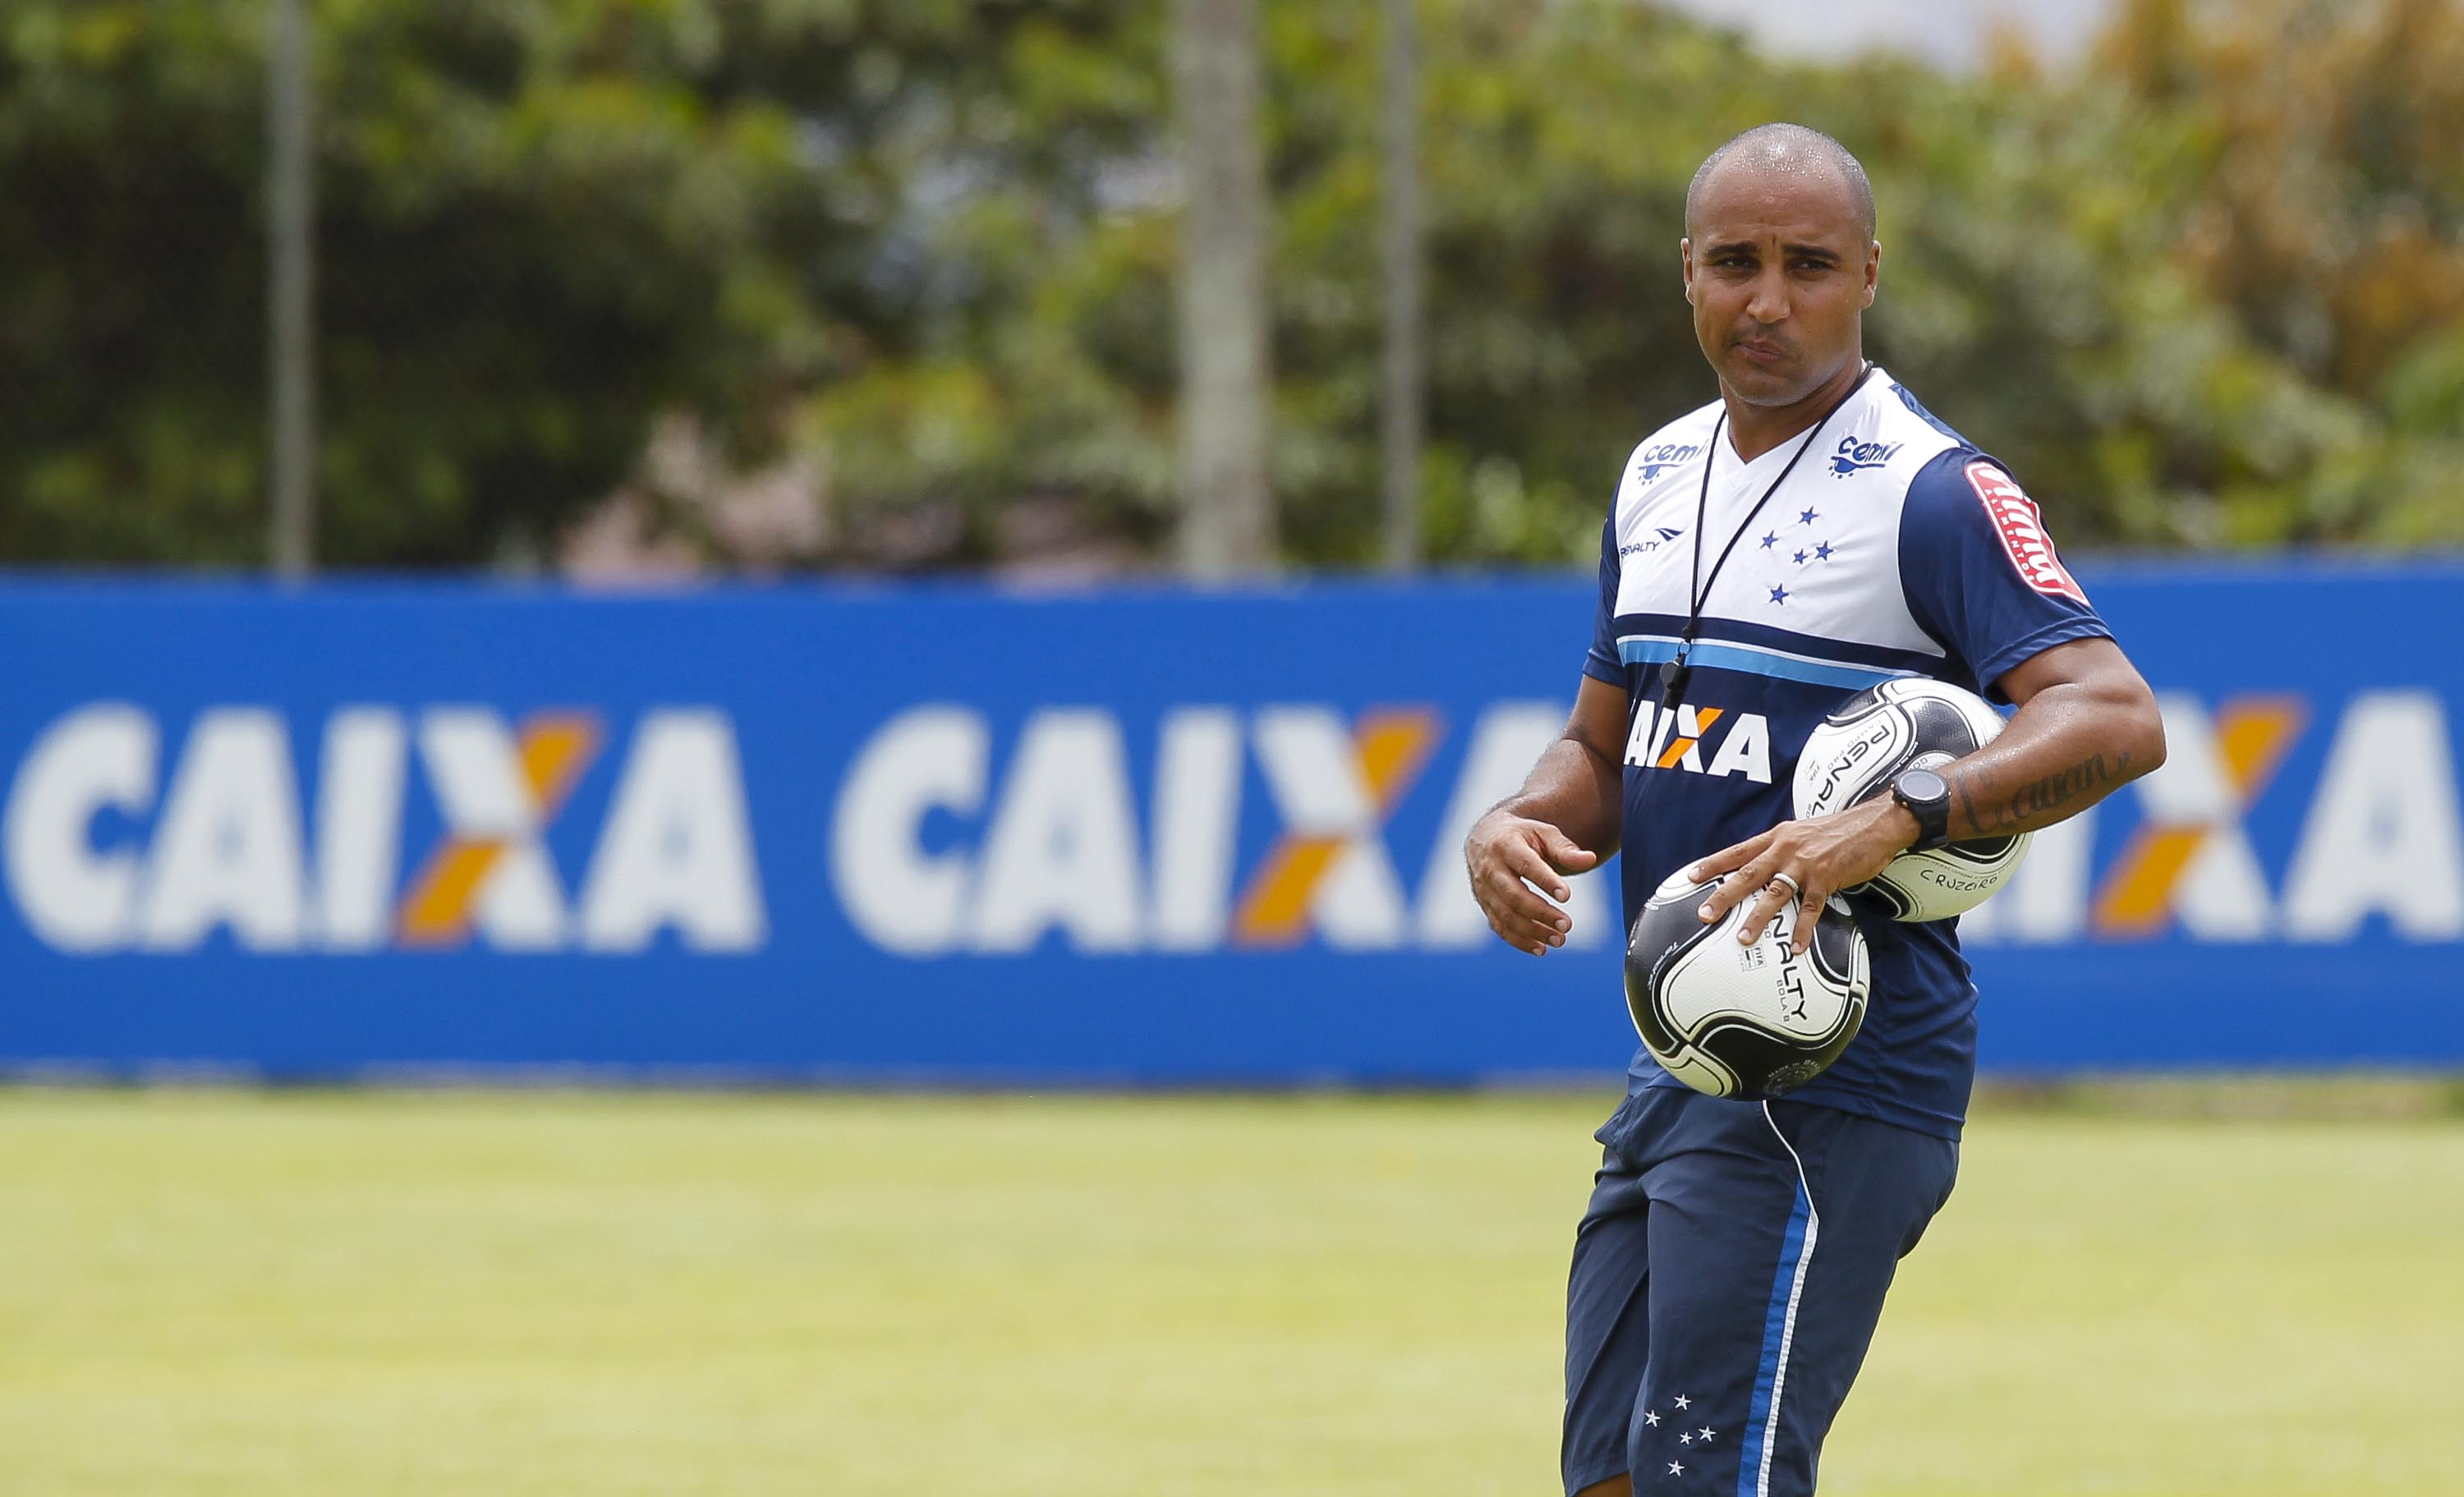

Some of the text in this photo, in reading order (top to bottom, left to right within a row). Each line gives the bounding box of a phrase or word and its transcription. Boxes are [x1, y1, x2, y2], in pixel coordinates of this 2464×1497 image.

[1984, 489, 2035, 581] ALIMENTOS
[1624, 699, 1772, 784] AIXA
[1811, 724, 1891, 816] PENAL
[4, 704, 765, 953] CAIXA
[1920, 869, 1997, 892] CRUZEIRO
[1754, 946, 1764, 967] FIFA
[1772, 913, 1808, 1021] NALTY
[1776, 980, 1789, 1011] BOLA
